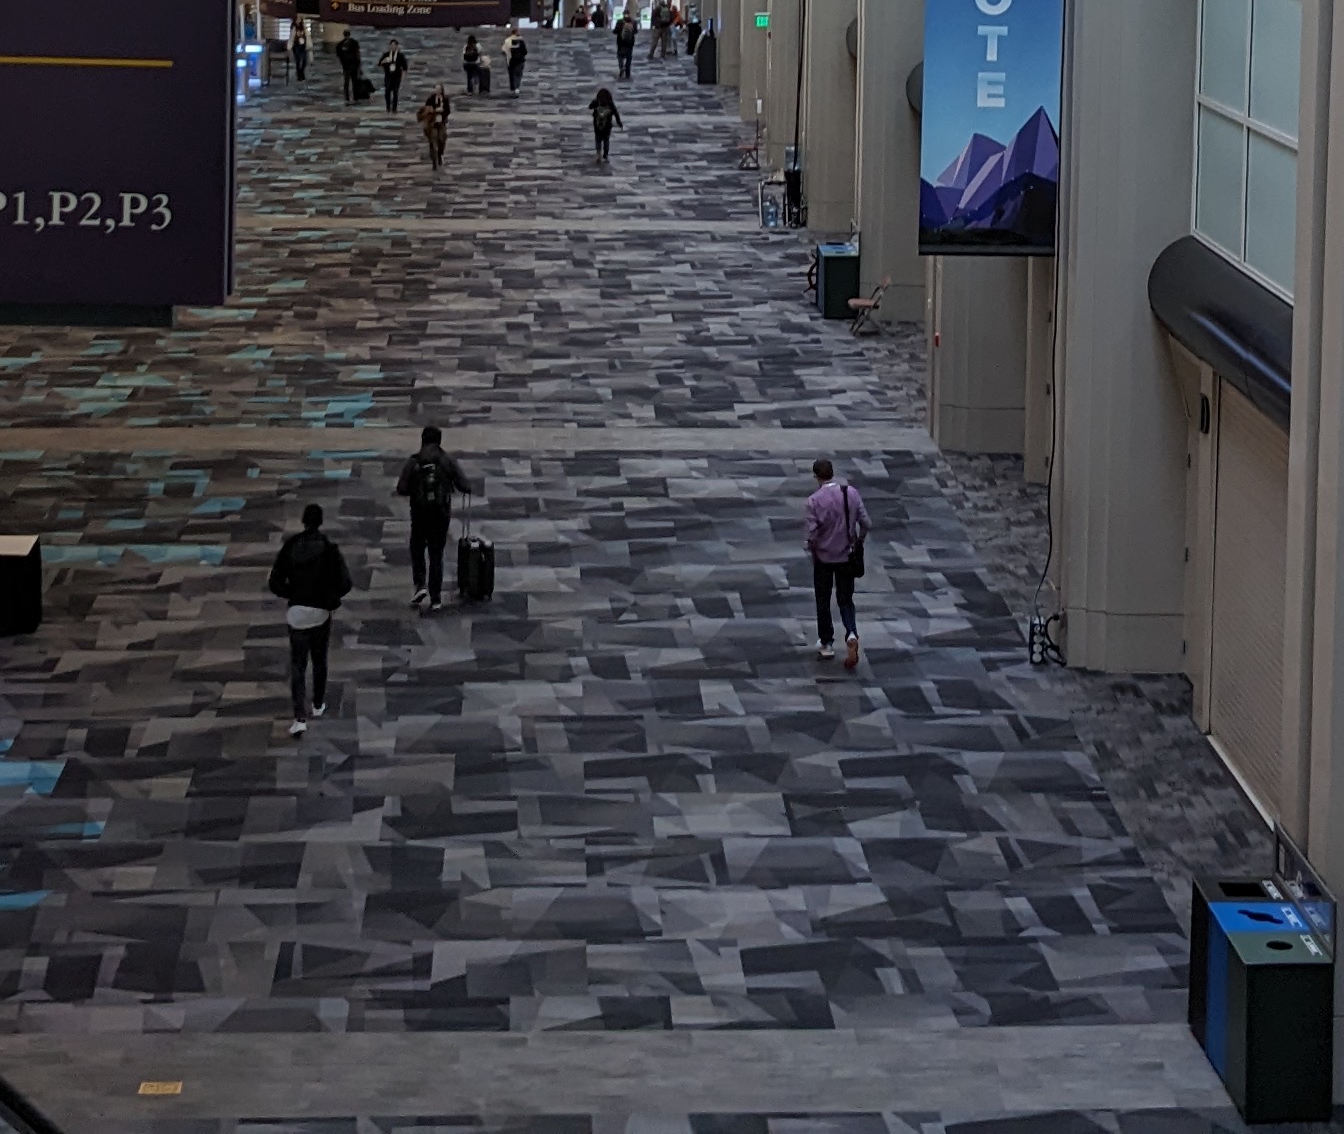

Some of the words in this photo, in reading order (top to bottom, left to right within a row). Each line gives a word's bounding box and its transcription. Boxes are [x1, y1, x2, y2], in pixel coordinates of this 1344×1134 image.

[347, 3, 365, 14] Bus
[367, 4, 405, 15] Loading
[406, 4, 432, 15] Zone
